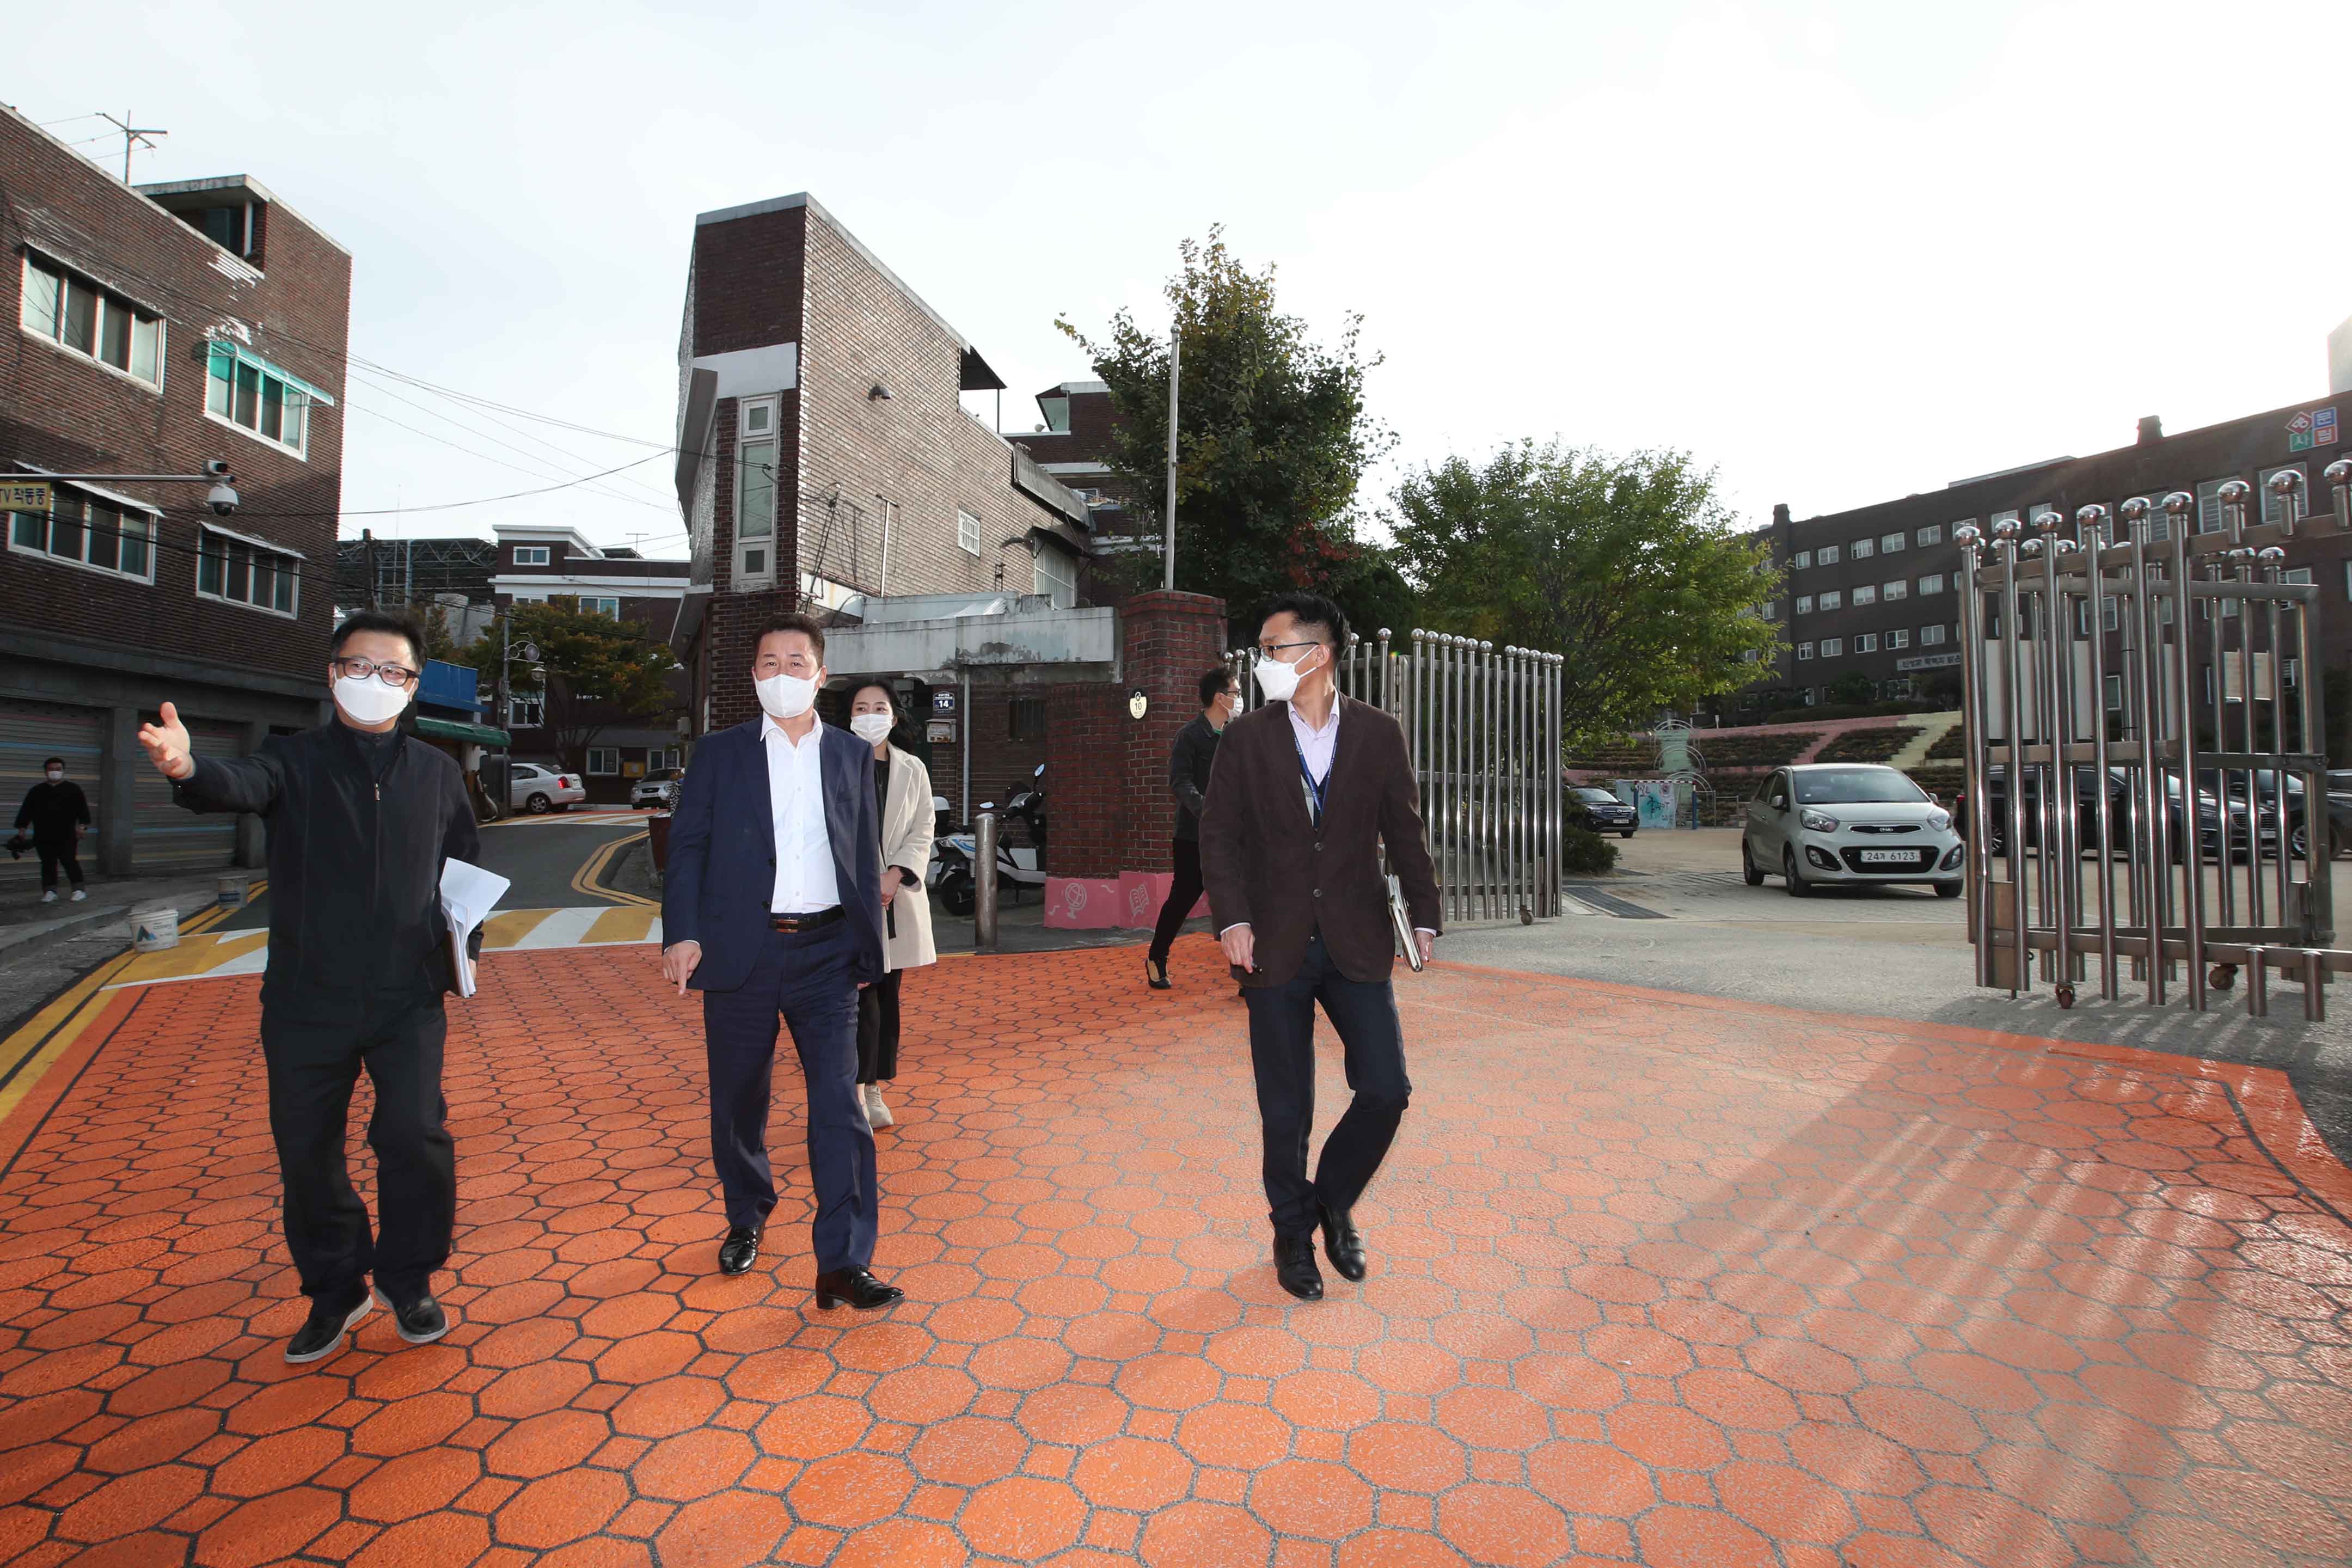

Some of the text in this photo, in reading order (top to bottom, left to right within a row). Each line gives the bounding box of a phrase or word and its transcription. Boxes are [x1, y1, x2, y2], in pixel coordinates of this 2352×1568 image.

[14, 487, 46, 505] 작동중
[1135, 702, 1142, 710] 10
[1890, 852, 1915, 861] 6123
